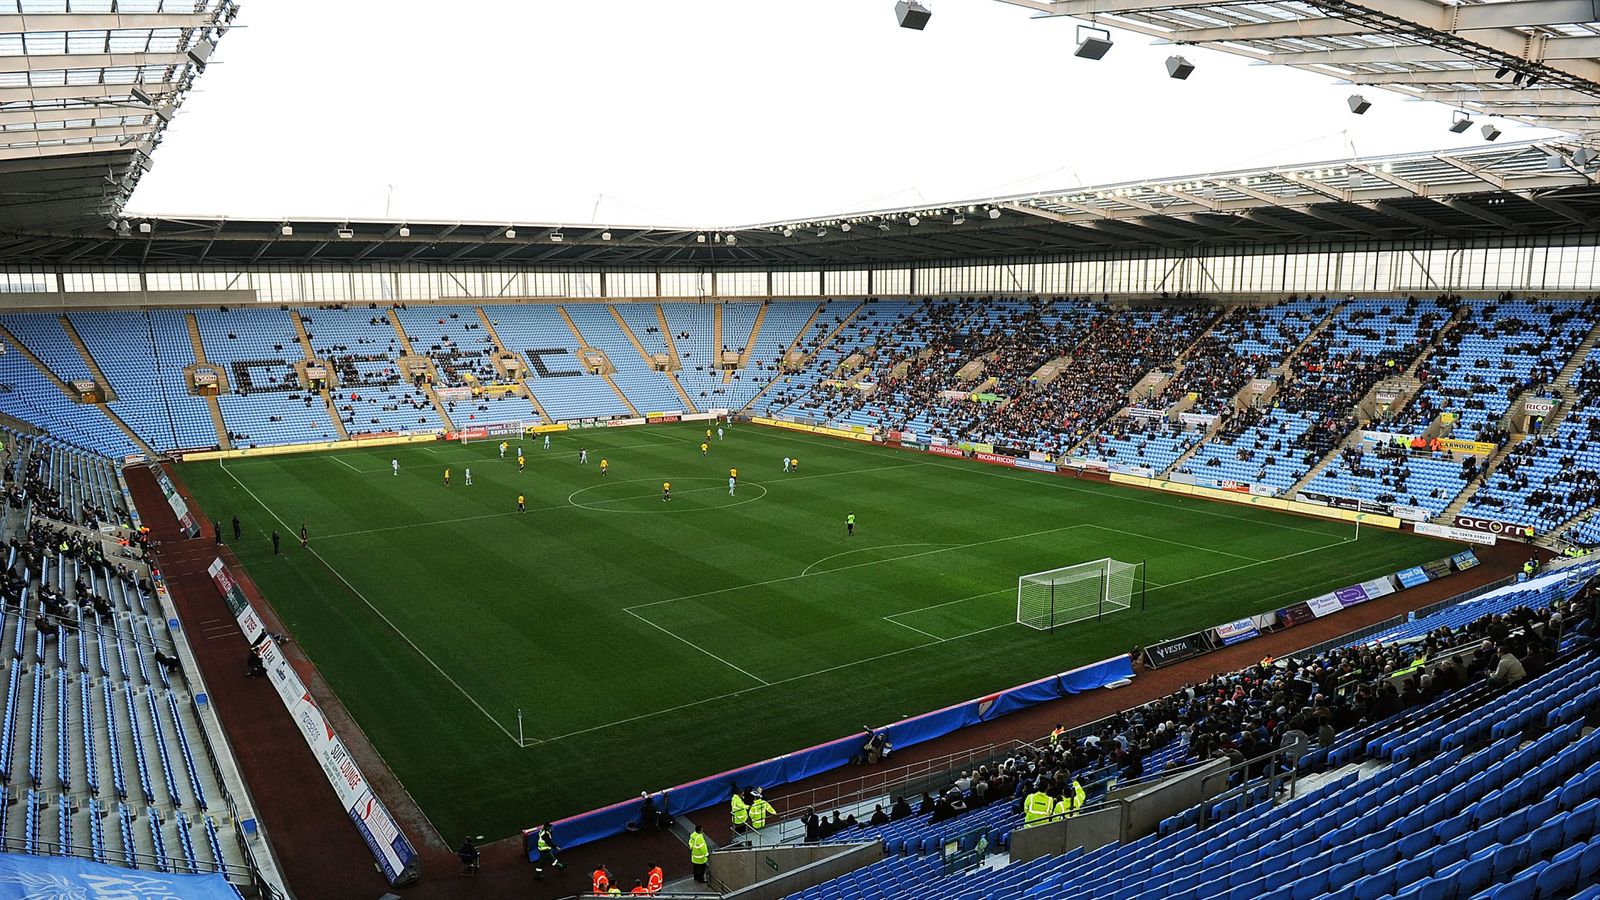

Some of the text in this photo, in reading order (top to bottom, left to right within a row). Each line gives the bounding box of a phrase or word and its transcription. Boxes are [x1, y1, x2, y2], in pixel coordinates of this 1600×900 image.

[1439, 441, 1474, 450] CARWOOD
[977, 453, 1015, 465] RICOH RICOH
[1458, 518, 1527, 535] acorn
[1163, 642, 1187, 656] VESTA
[330, 743, 346, 764] SUIT
[341, 759, 361, 791] LOUNGE
